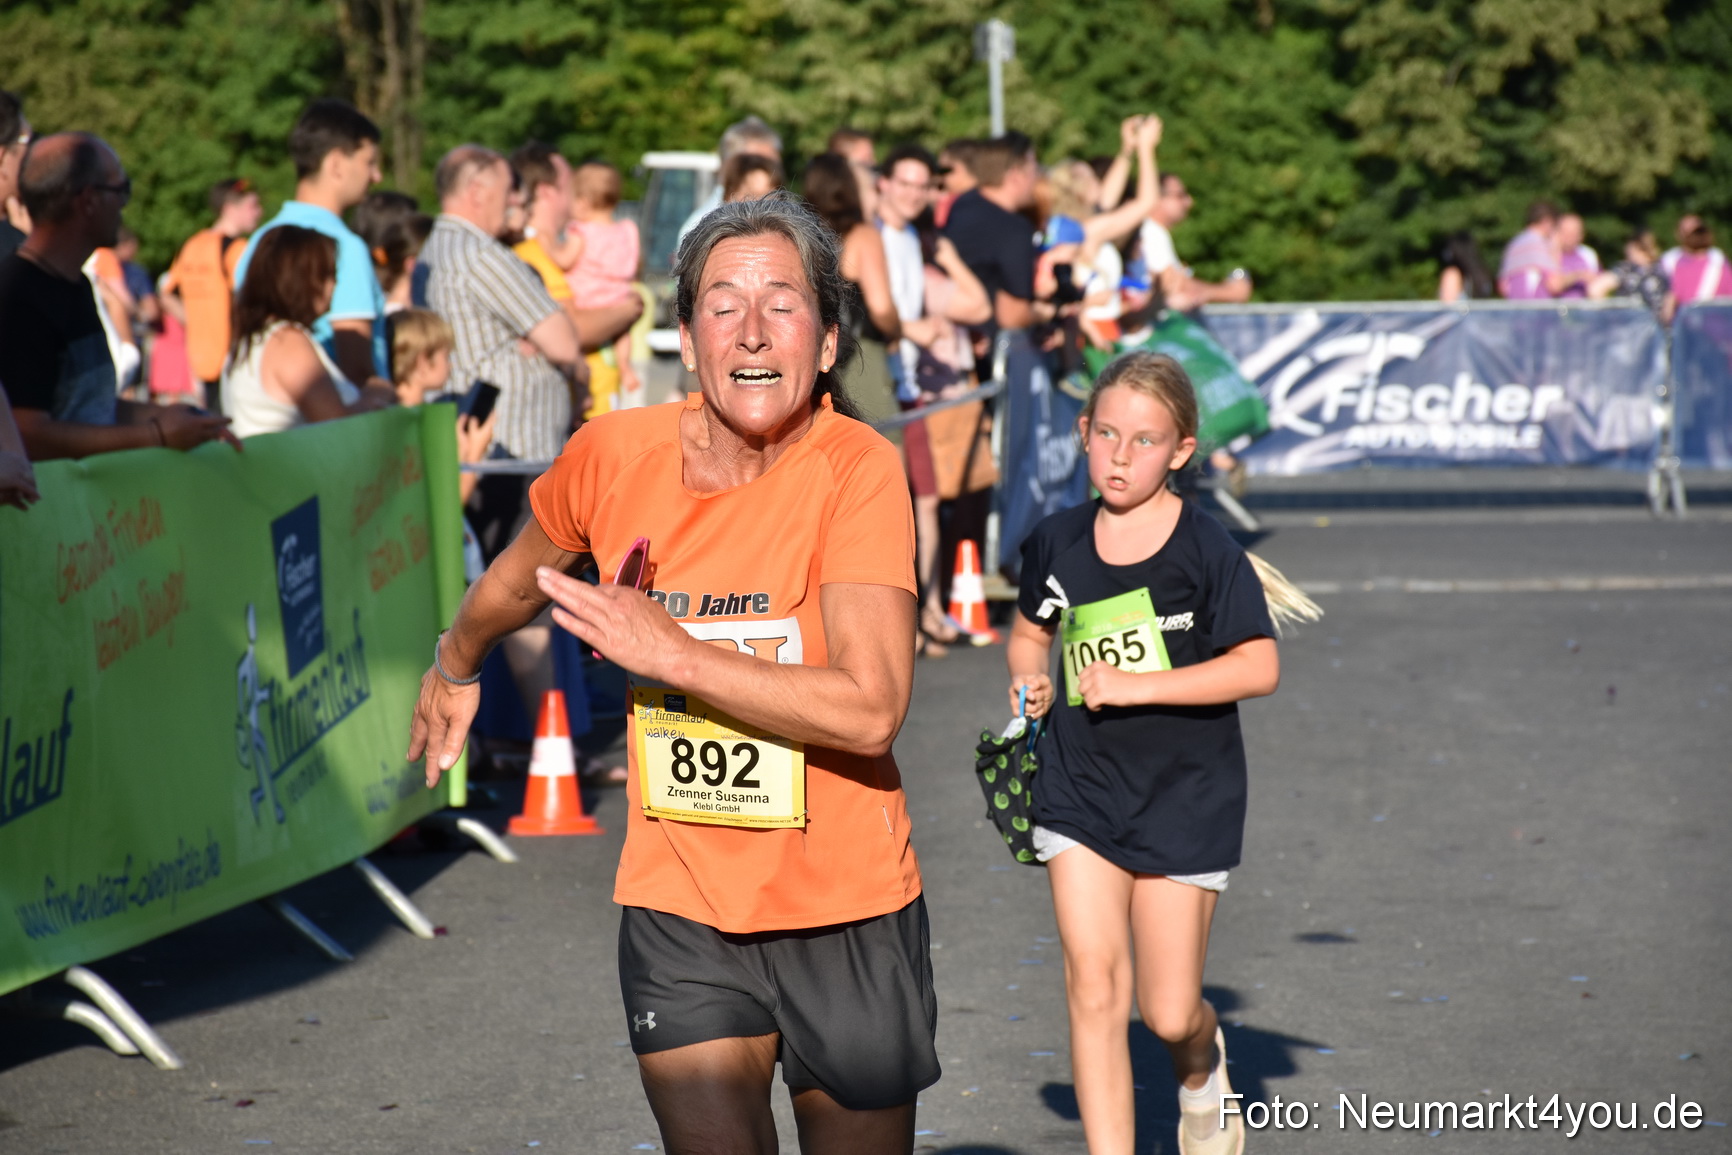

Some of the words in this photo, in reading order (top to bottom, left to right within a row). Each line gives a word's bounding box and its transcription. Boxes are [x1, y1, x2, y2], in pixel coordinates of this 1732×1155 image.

[1319, 372, 1564, 423] Fischer
[1344, 423, 1544, 449] AUTOMOBILE
[695, 592, 770, 617] Jahre
[1069, 629, 1146, 677] 1065
[267, 607, 371, 772] firmenlauf
[655, 709, 708, 724] firmenlauf
[645, 726, 686, 740] walken
[671, 738, 760, 789] 892
[667, 786, 712, 800] Zrenner
[715, 790, 770, 804] Susanna
[693, 802, 713, 811] Klebl
[715, 804, 741, 813] GmbH
